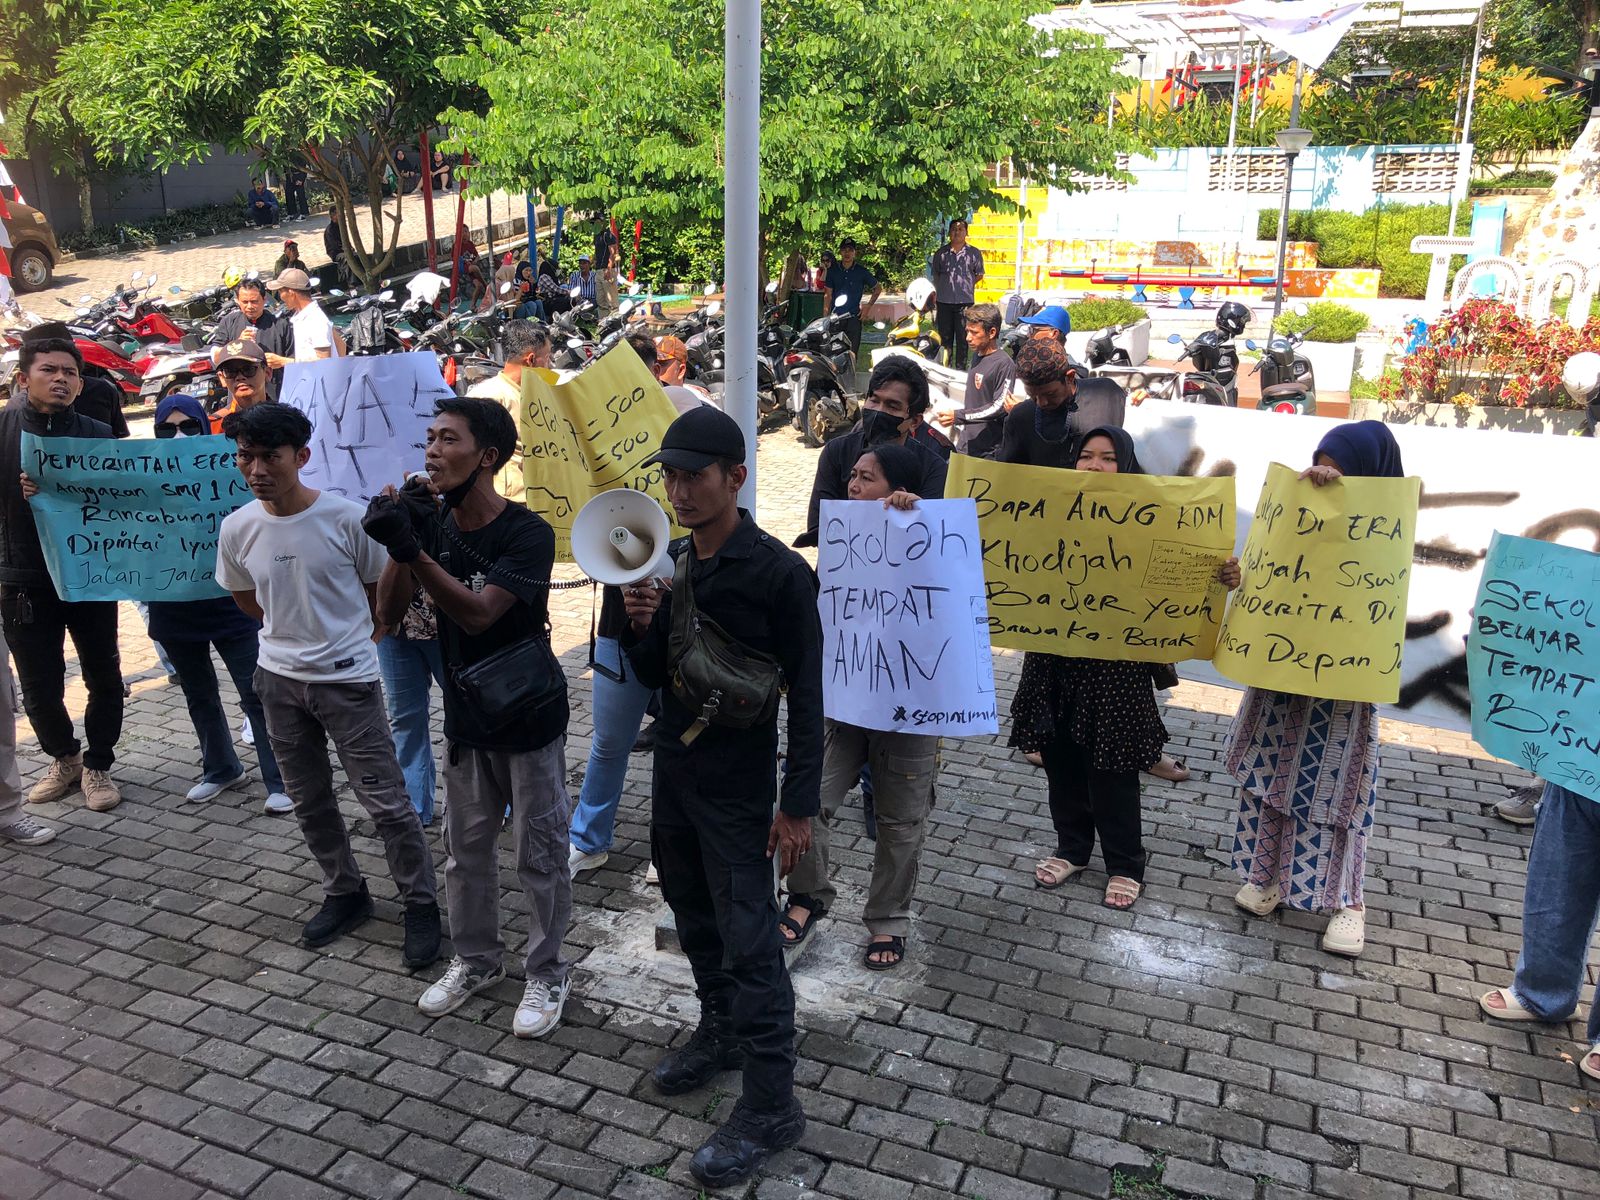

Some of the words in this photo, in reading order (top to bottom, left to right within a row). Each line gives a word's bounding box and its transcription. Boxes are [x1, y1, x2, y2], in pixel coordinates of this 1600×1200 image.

[606, 386, 645, 427] 500
[611, 431, 649, 461] 500
[210, 479, 220, 501] 1
[1177, 503, 1224, 531] KDM
[823, 585, 951, 627] TEMPAT
[833, 629, 952, 693] AMAN
[1264, 633, 1370, 682] Depan
[1480, 644, 1596, 698] TEMPAT
